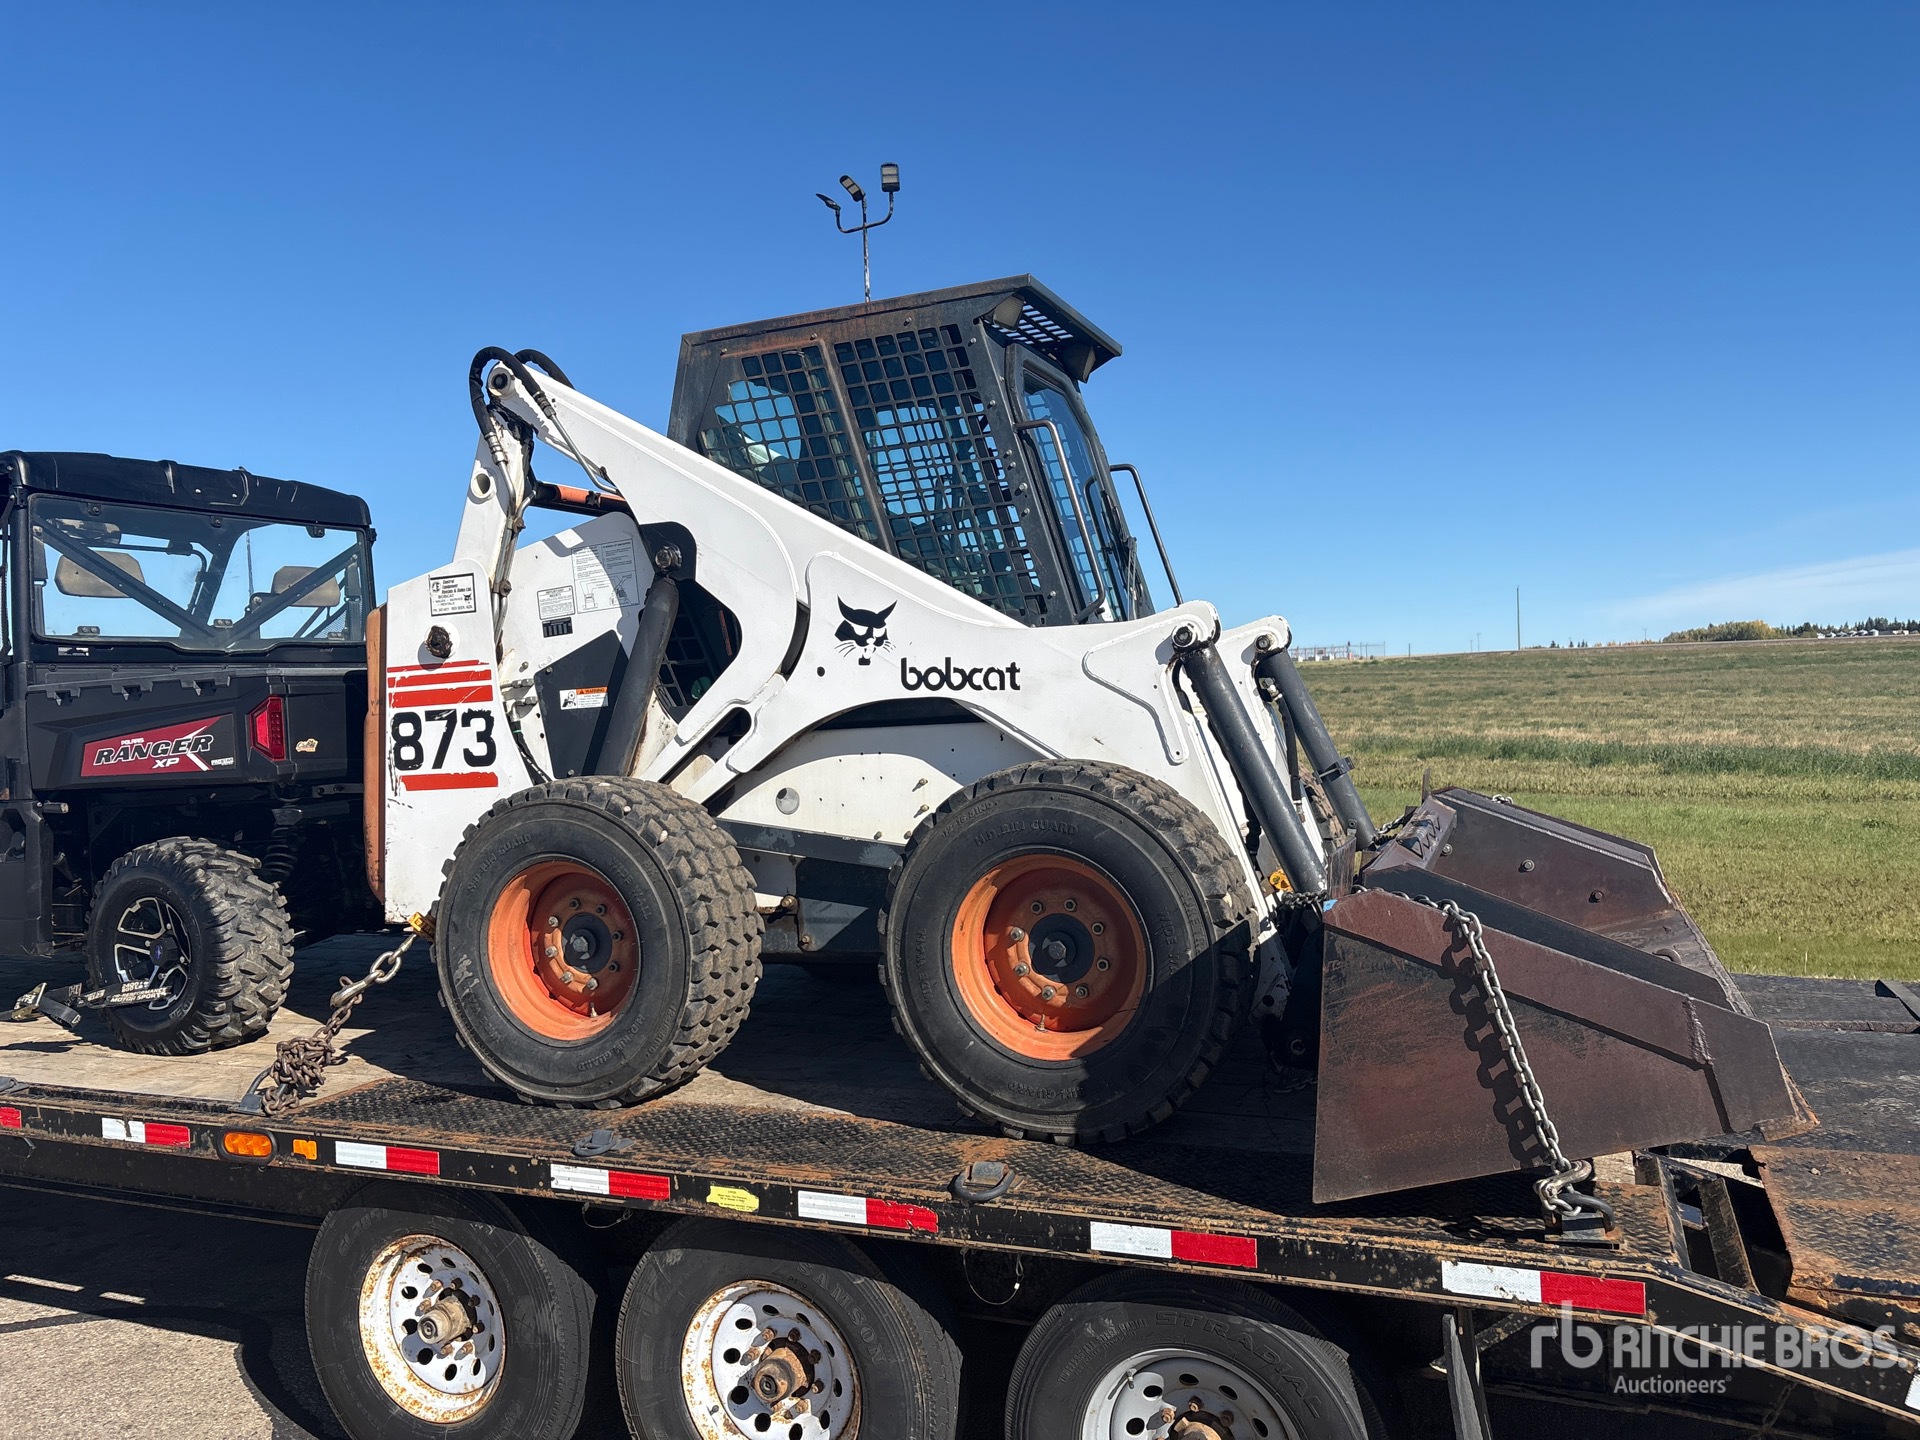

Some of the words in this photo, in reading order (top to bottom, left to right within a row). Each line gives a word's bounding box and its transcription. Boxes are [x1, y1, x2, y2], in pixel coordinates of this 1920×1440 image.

[901, 657, 1021, 691] bobcat
[93, 734, 214, 765] RANGER
[391, 708, 497, 771] 873
[152, 757, 180, 769] XP
[796, 1262, 887, 1364] SAMSON
